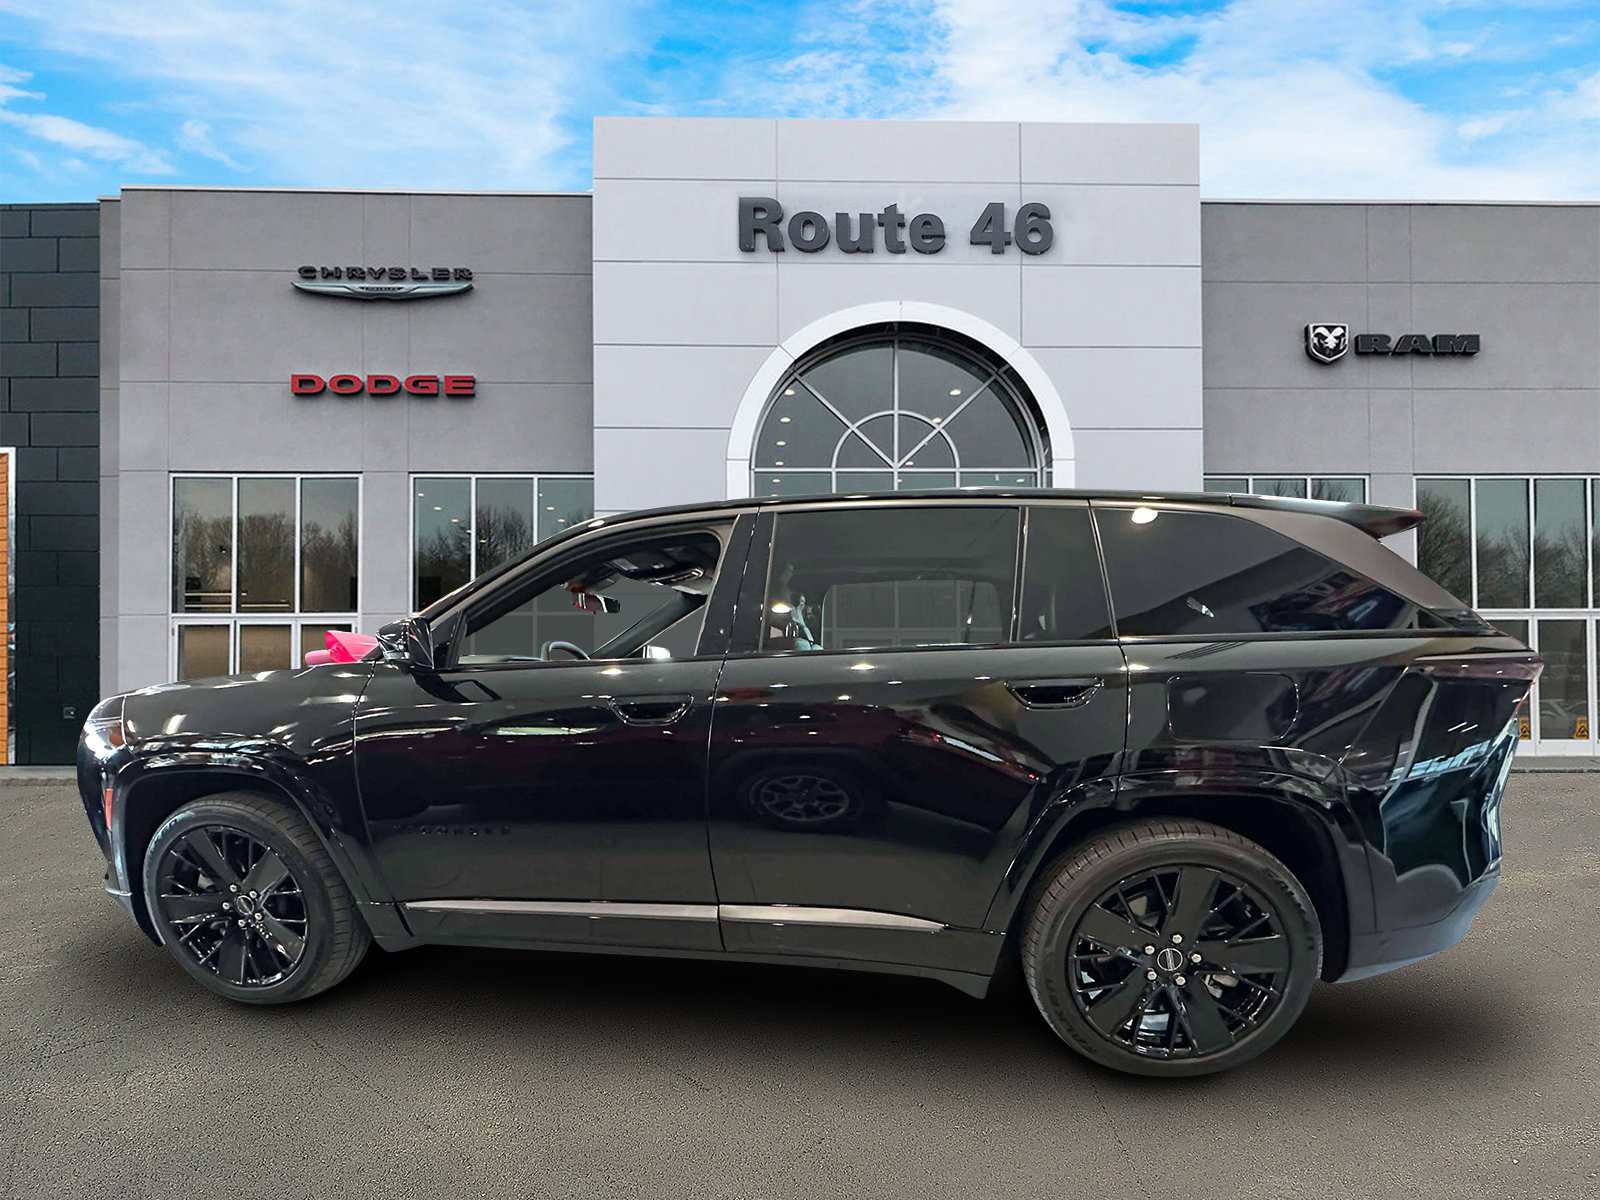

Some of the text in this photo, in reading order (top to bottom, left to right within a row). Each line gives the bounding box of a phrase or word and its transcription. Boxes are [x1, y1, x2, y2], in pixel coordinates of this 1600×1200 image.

[738, 196, 1054, 256] Route 46
[298, 265, 473, 280] CHRYSLER
[1354, 333, 1480, 355] RAM
[291, 373, 476, 397] DODGE
